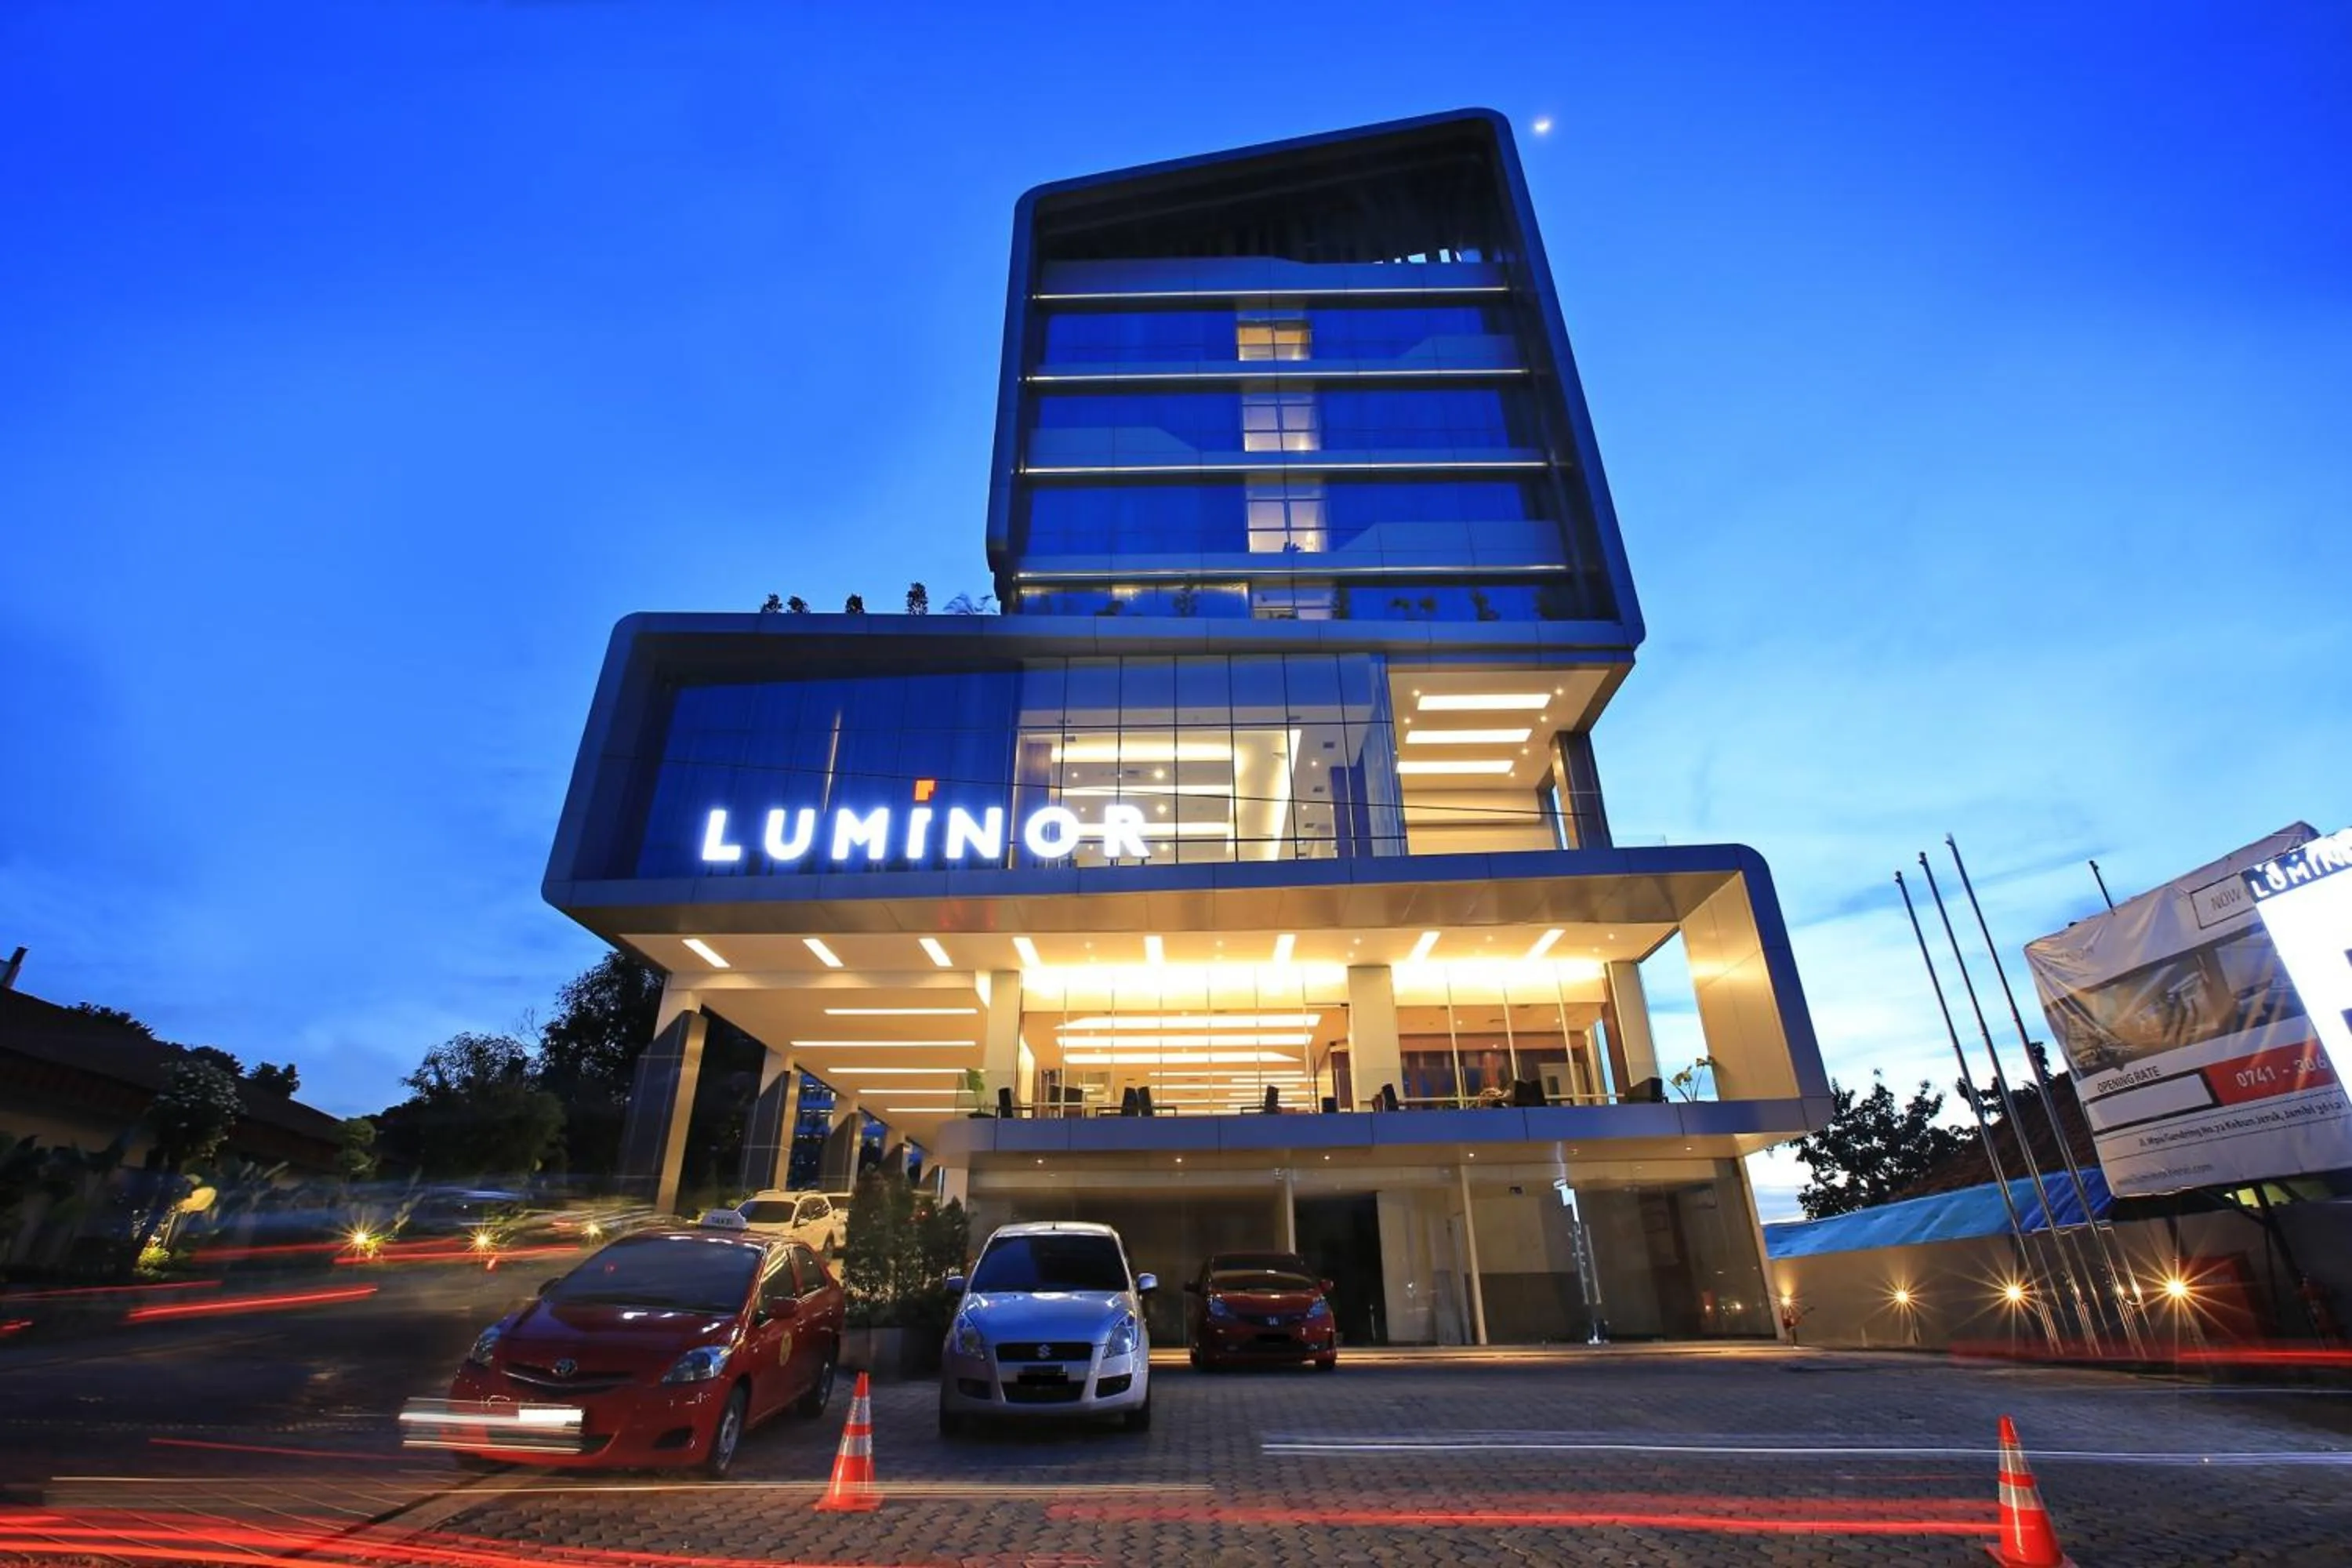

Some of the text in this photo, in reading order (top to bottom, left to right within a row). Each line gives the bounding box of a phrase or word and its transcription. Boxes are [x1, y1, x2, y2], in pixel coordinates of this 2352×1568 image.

[702, 779, 1151, 862] LUMINOR
[2251, 831, 2352, 898] LUMIN
[2098, 1065, 2160, 1093] OPENING RATE
[2236, 1065, 2276, 1087] 0741
